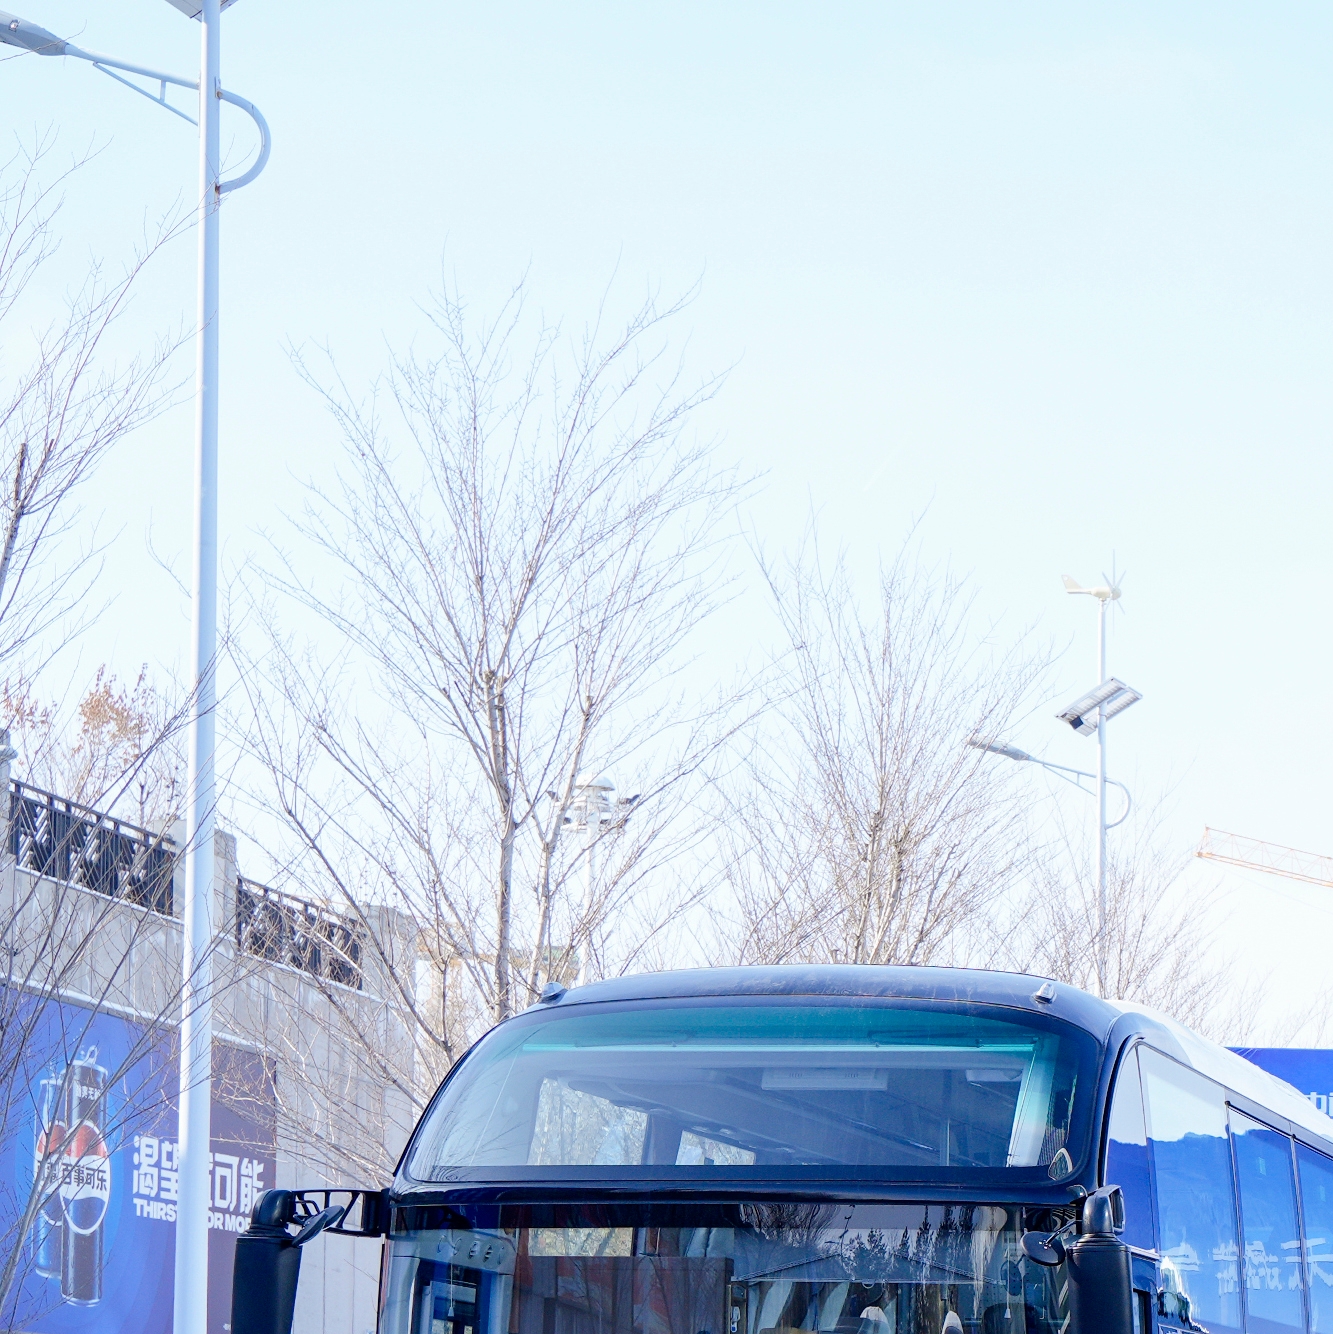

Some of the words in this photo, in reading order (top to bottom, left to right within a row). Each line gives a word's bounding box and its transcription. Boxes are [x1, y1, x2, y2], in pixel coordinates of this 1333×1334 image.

[61, 1162, 107, 1191] 百事可乐
[133, 1135, 264, 1214] 渴望可能
[133, 1198, 178, 1222] THIRS
[207, 1211, 223, 1230] OR
